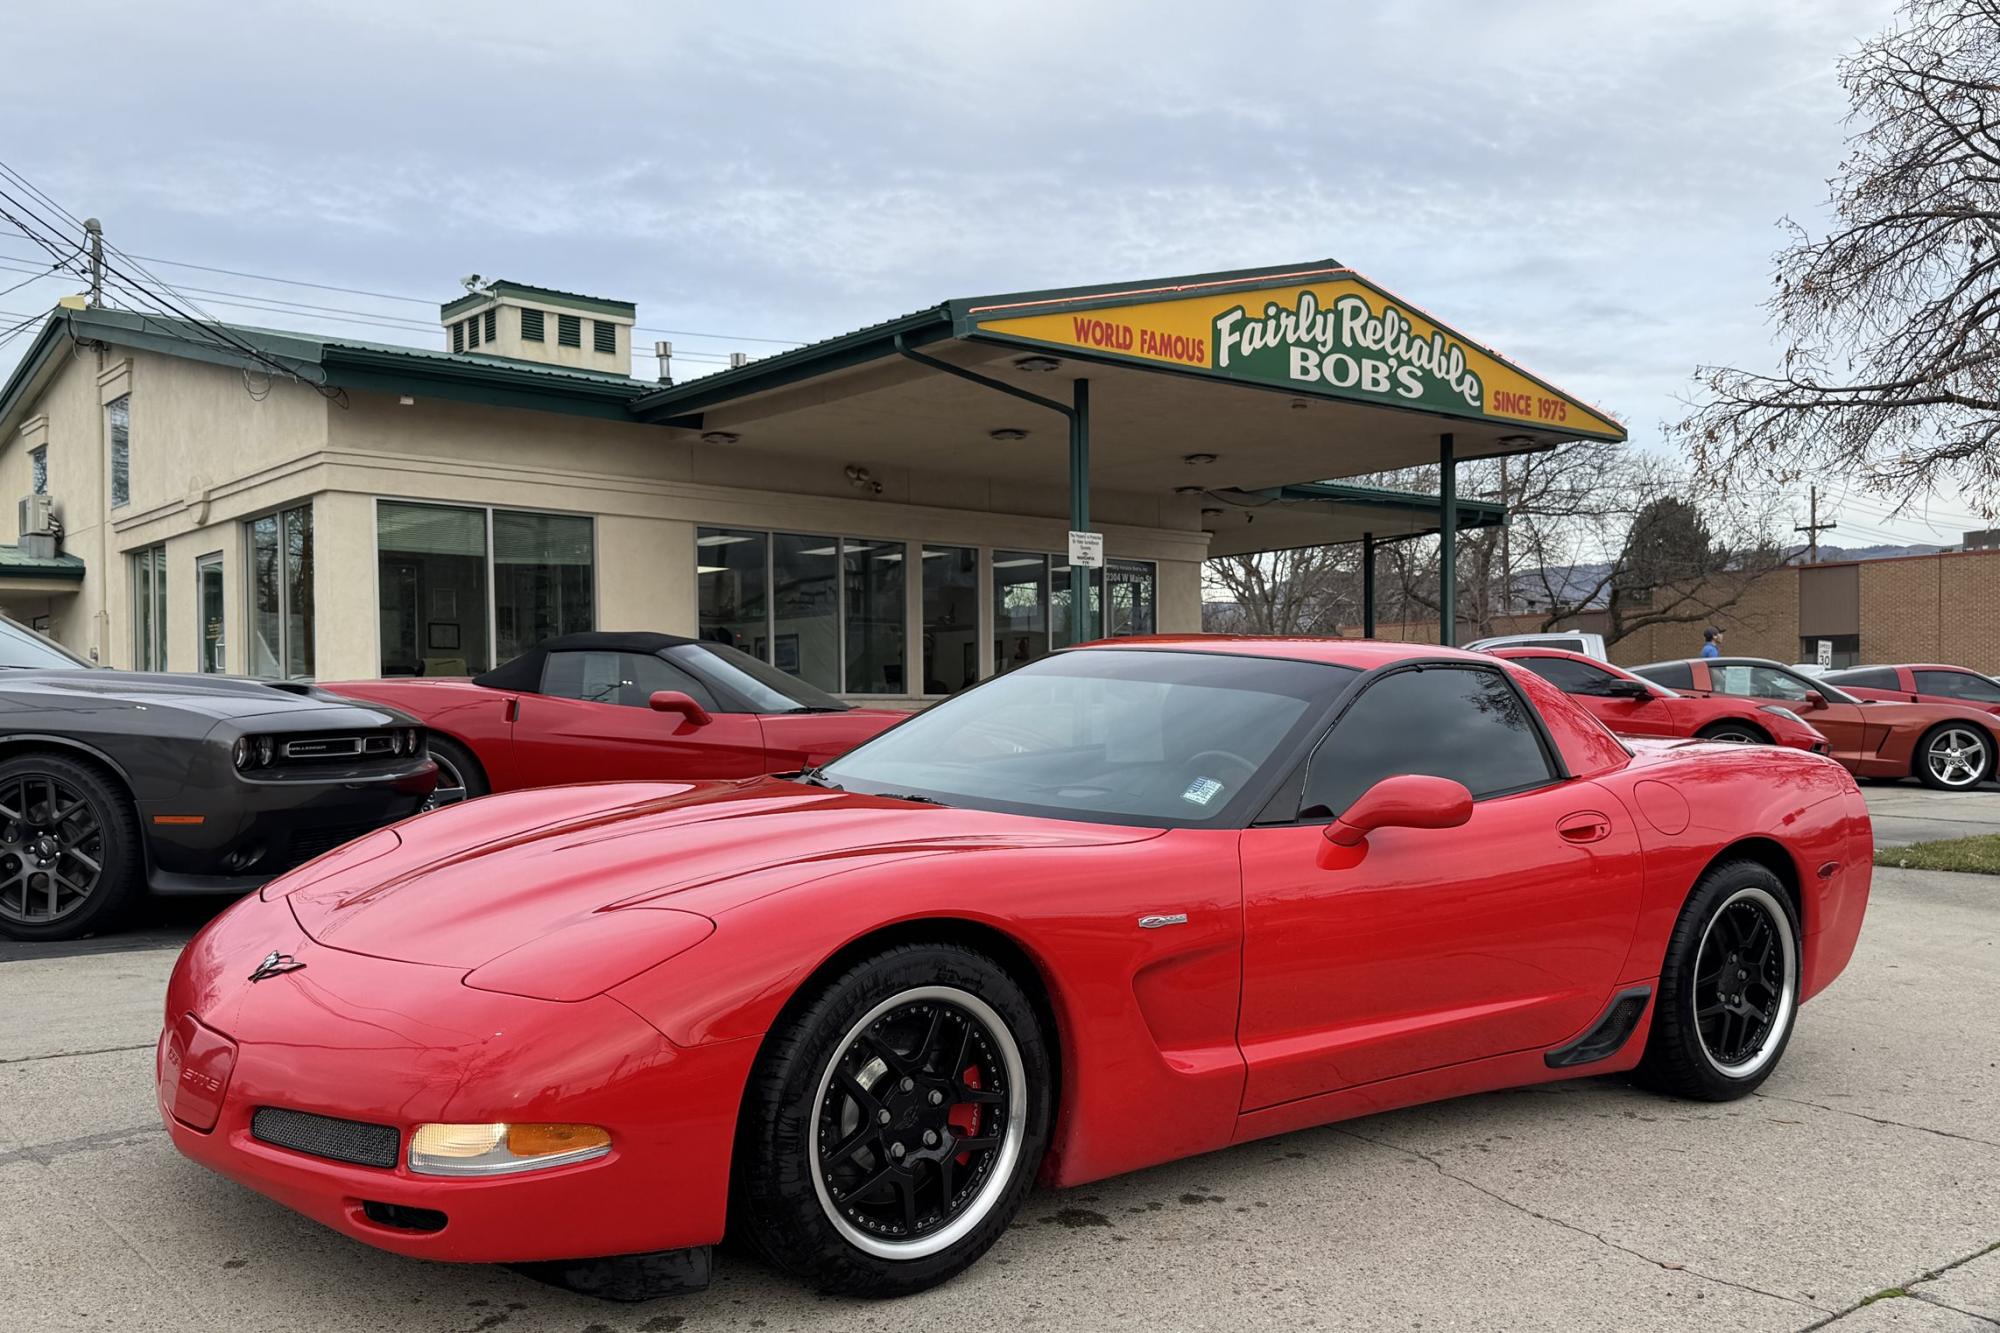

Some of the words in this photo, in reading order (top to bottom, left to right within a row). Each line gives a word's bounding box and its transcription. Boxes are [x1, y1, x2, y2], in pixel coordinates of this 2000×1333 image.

[1073, 316, 1134, 351] WORLD
[1140, 328, 1205, 363] FAMOUS
[1217, 294, 1334, 367] Fairly
[1337, 298, 1481, 407] Reliable
[1289, 346, 1424, 398] BOB'S
[1493, 390, 1532, 416] SINCE
[1537, 397, 1567, 421] 1975
[1819, 655, 1830, 666] 30
